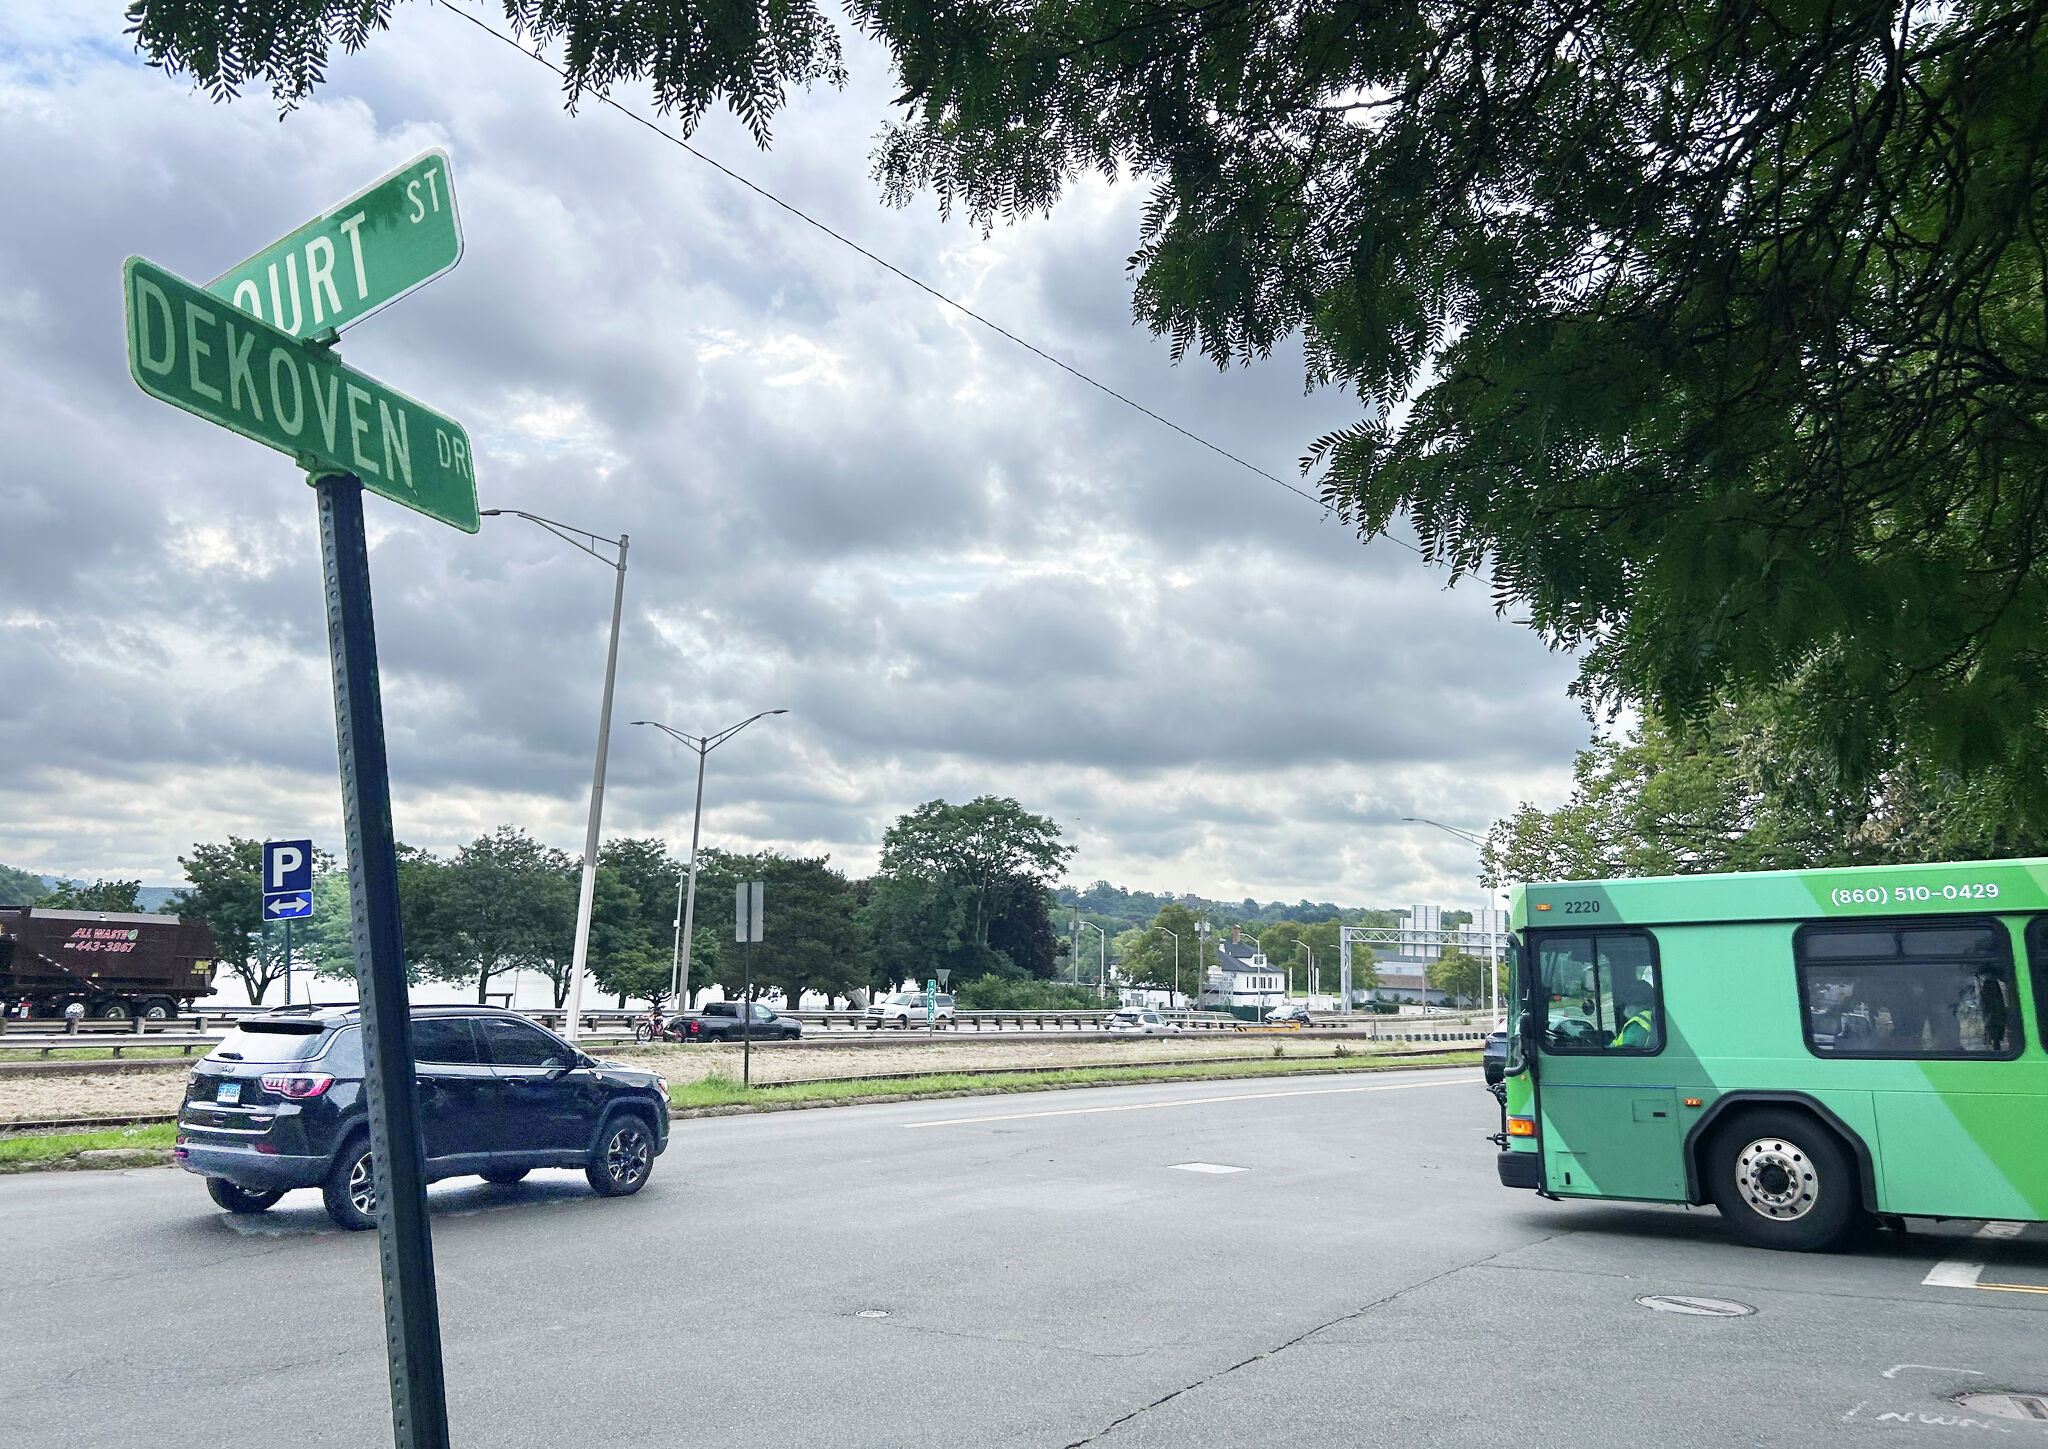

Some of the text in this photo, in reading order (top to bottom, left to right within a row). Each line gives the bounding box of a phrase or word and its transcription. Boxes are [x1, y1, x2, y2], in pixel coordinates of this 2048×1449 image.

[407, 168, 440, 224] ST
[135, 275, 468, 488] DEKOVEN DR
[273, 847, 303, 887] P
[1565, 901, 1600, 914] 2220
[1831, 883, 1999, 907] (860) 510-0429
[71, 928, 130, 940] ALL WASTE
